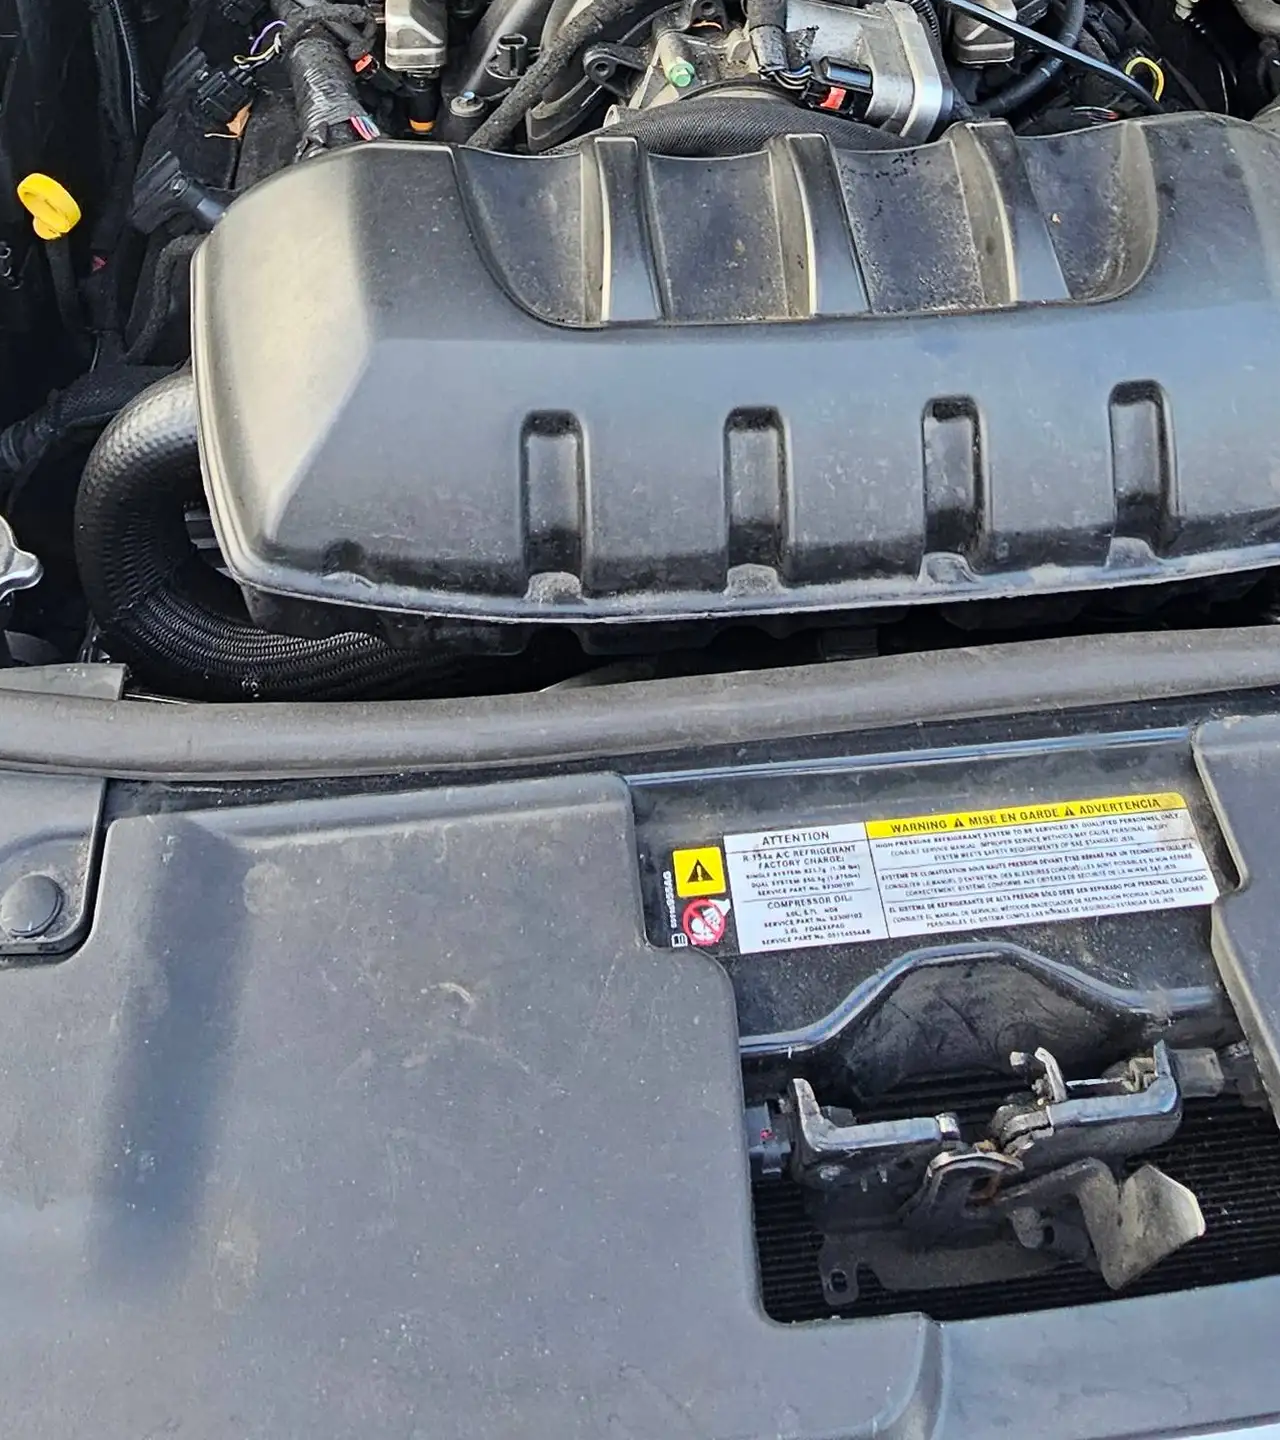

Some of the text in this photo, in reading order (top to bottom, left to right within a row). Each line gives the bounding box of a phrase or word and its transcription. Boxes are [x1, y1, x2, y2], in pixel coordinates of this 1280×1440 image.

[890, 799, 1161, 833] WARNING MISE EN GARDE ADVERTENCIA
[761, 830, 830, 845] ATTENTION
[792, 844, 856, 857] REFRIGERANT
[758, 859, 801, 870] FACTORY
[757, 888, 786, 896] SERVICE
[767, 895, 831, 909] COMPRESSOR
[763, 920, 793, 928] SERVICE
[761, 937, 791, 946] SERVICE
[794, 934, 813, 942] PART
